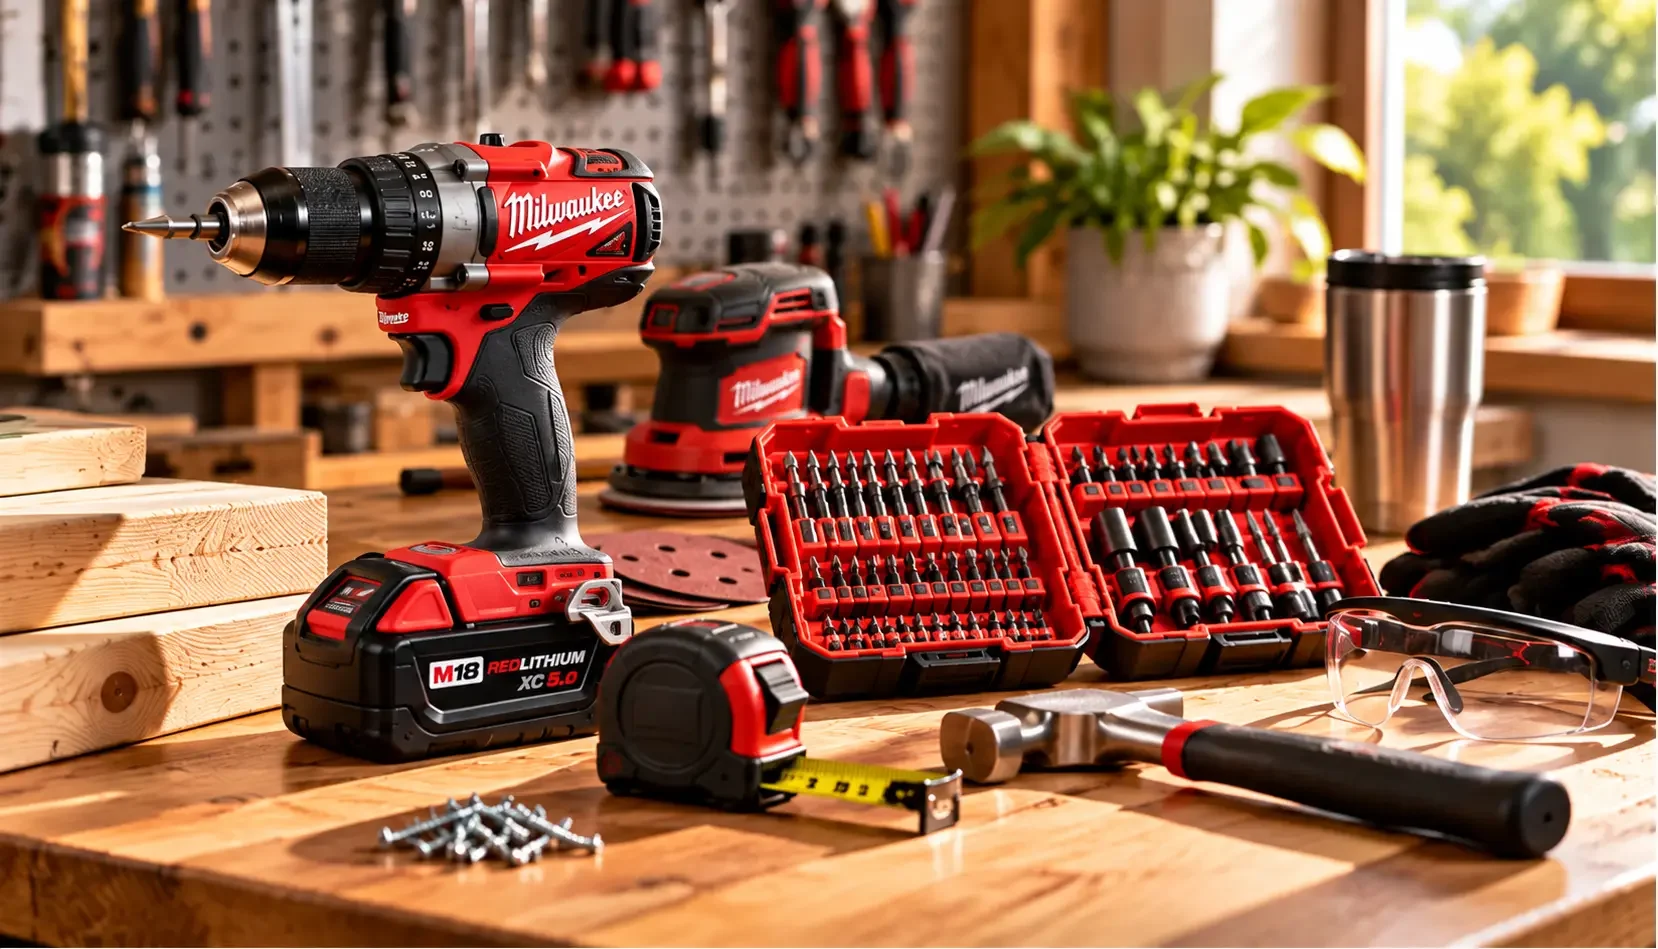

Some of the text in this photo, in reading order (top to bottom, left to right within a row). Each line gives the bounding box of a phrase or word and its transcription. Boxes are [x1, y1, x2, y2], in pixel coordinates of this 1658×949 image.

[504, 187, 625, 239] Milwaukee
[433, 650, 586, 685] M18 REDLITHIUM
[517, 671, 578, 692] XC 5.0
